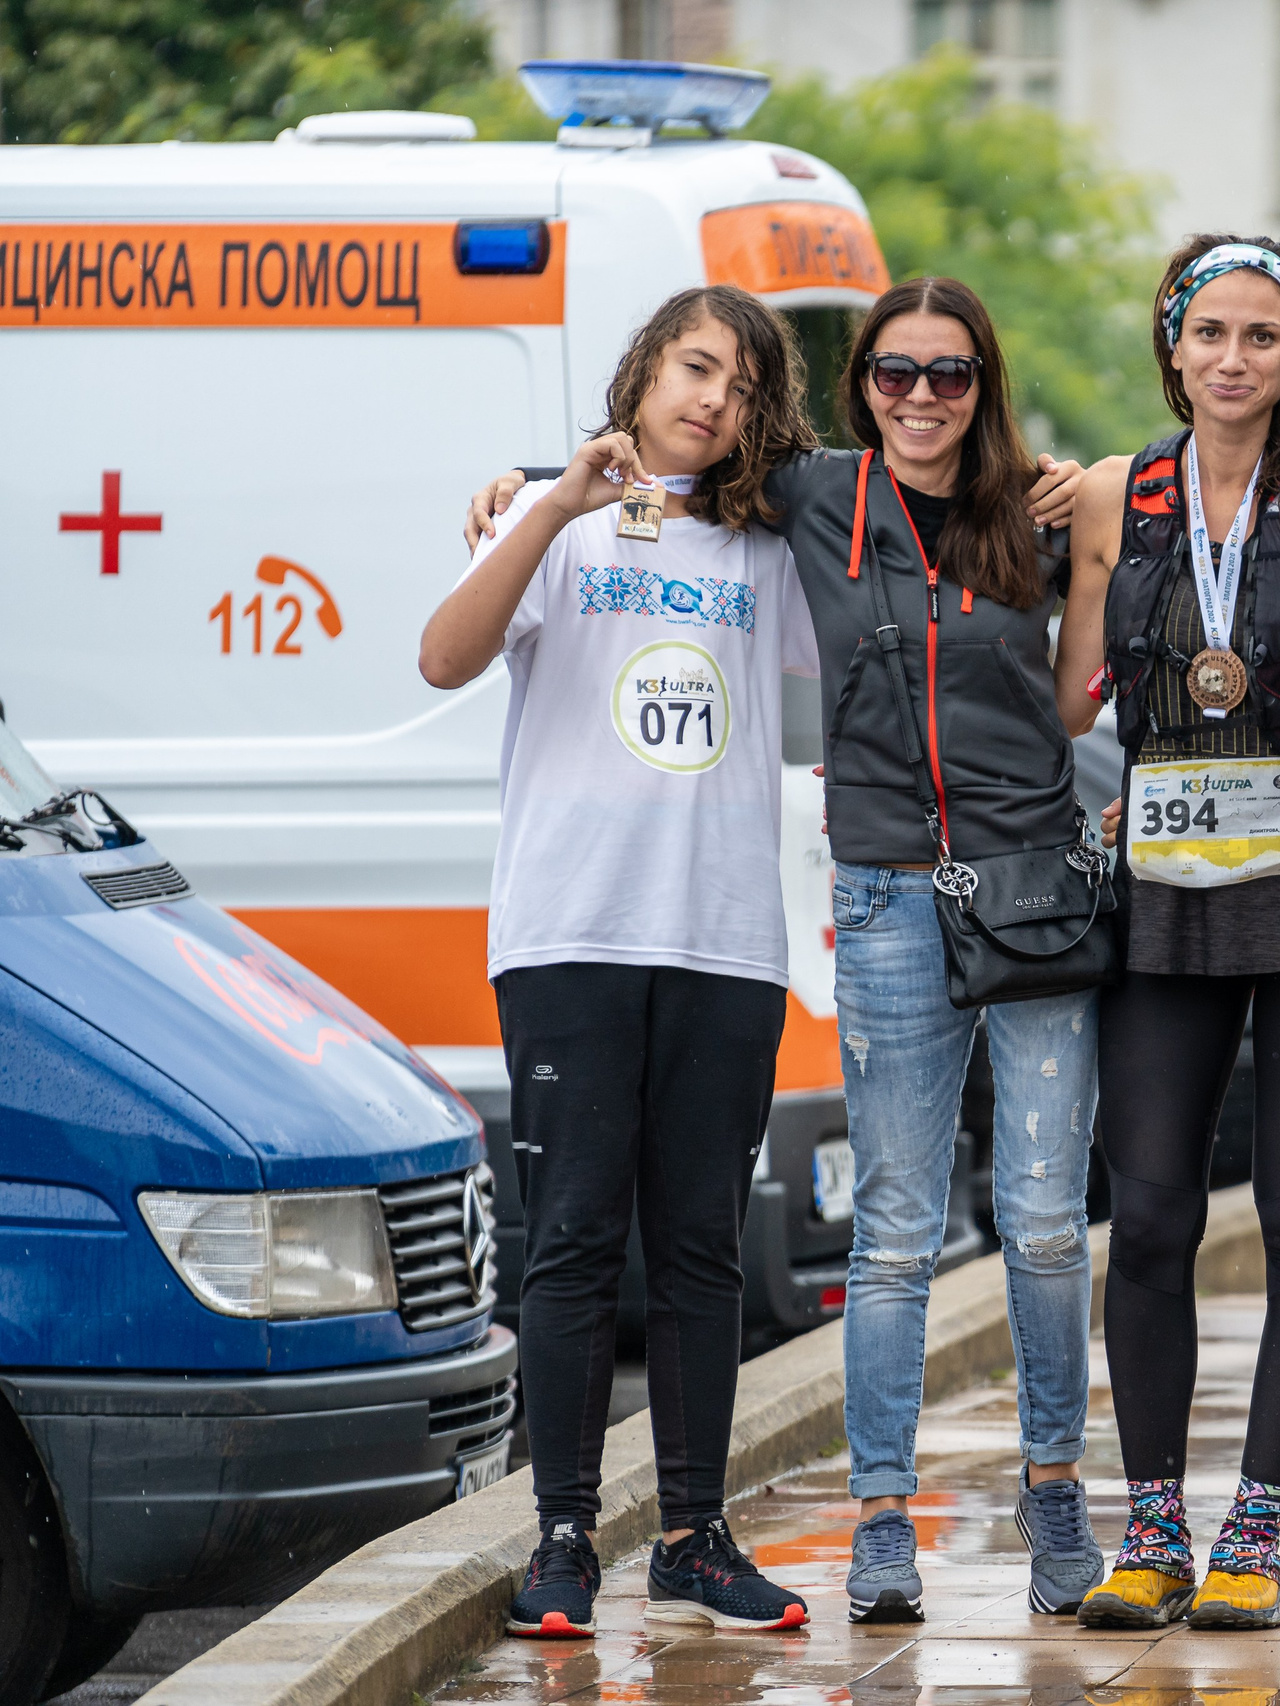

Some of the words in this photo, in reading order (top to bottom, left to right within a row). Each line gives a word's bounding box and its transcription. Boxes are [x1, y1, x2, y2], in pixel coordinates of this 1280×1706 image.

[0, 241, 195, 322] ЦИНСКА
[219, 241, 422, 322] ПОМОЩ
[1228, 552, 1236, 566] 2020
[1223, 565, 1235, 602] ЗЛАТОГРАД
[1202, 577, 1212, 610] ЗЛАТОГРАД
[1207, 609, 1215, 623] 2020
[208, 591, 303, 656] 112
[1210, 655, 1233, 669] ULTRA
[636, 678, 659, 694] K3
[669, 681, 715, 694] ULTRA
[1200, 693, 1230, 704] BORDER
[1230, 673, 1238, 694] RACE
[640, 701, 714, 747] 071
[1181, 779, 1202, 794] K3
[1211, 778, 1254, 791] ULTRA
[1140, 797, 1219, 836] 394
[1015, 895, 1055, 906] GUESS
[531, 1073, 559, 1082] Kalenji
[553, 1522, 574, 1535] NIKE
